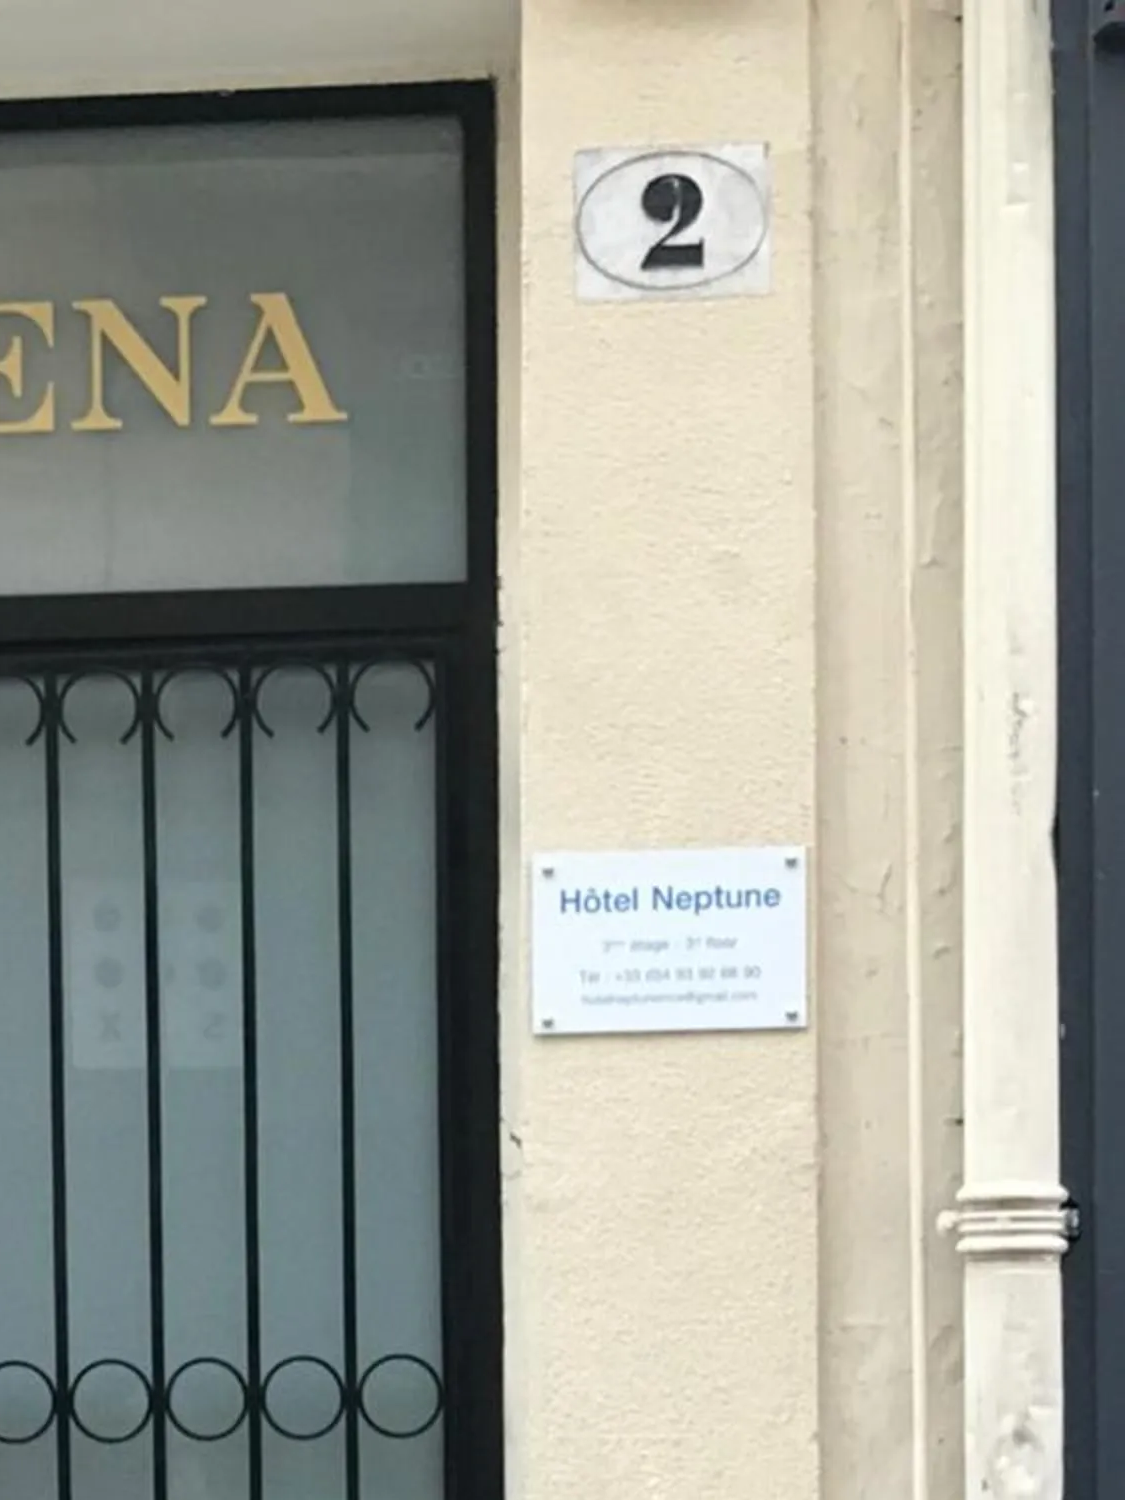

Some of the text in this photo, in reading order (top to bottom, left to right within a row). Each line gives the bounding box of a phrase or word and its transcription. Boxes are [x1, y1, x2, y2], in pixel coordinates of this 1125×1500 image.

[641, 174, 704, 271] 2
[559, 885, 782, 915] Hôtel Neptune
